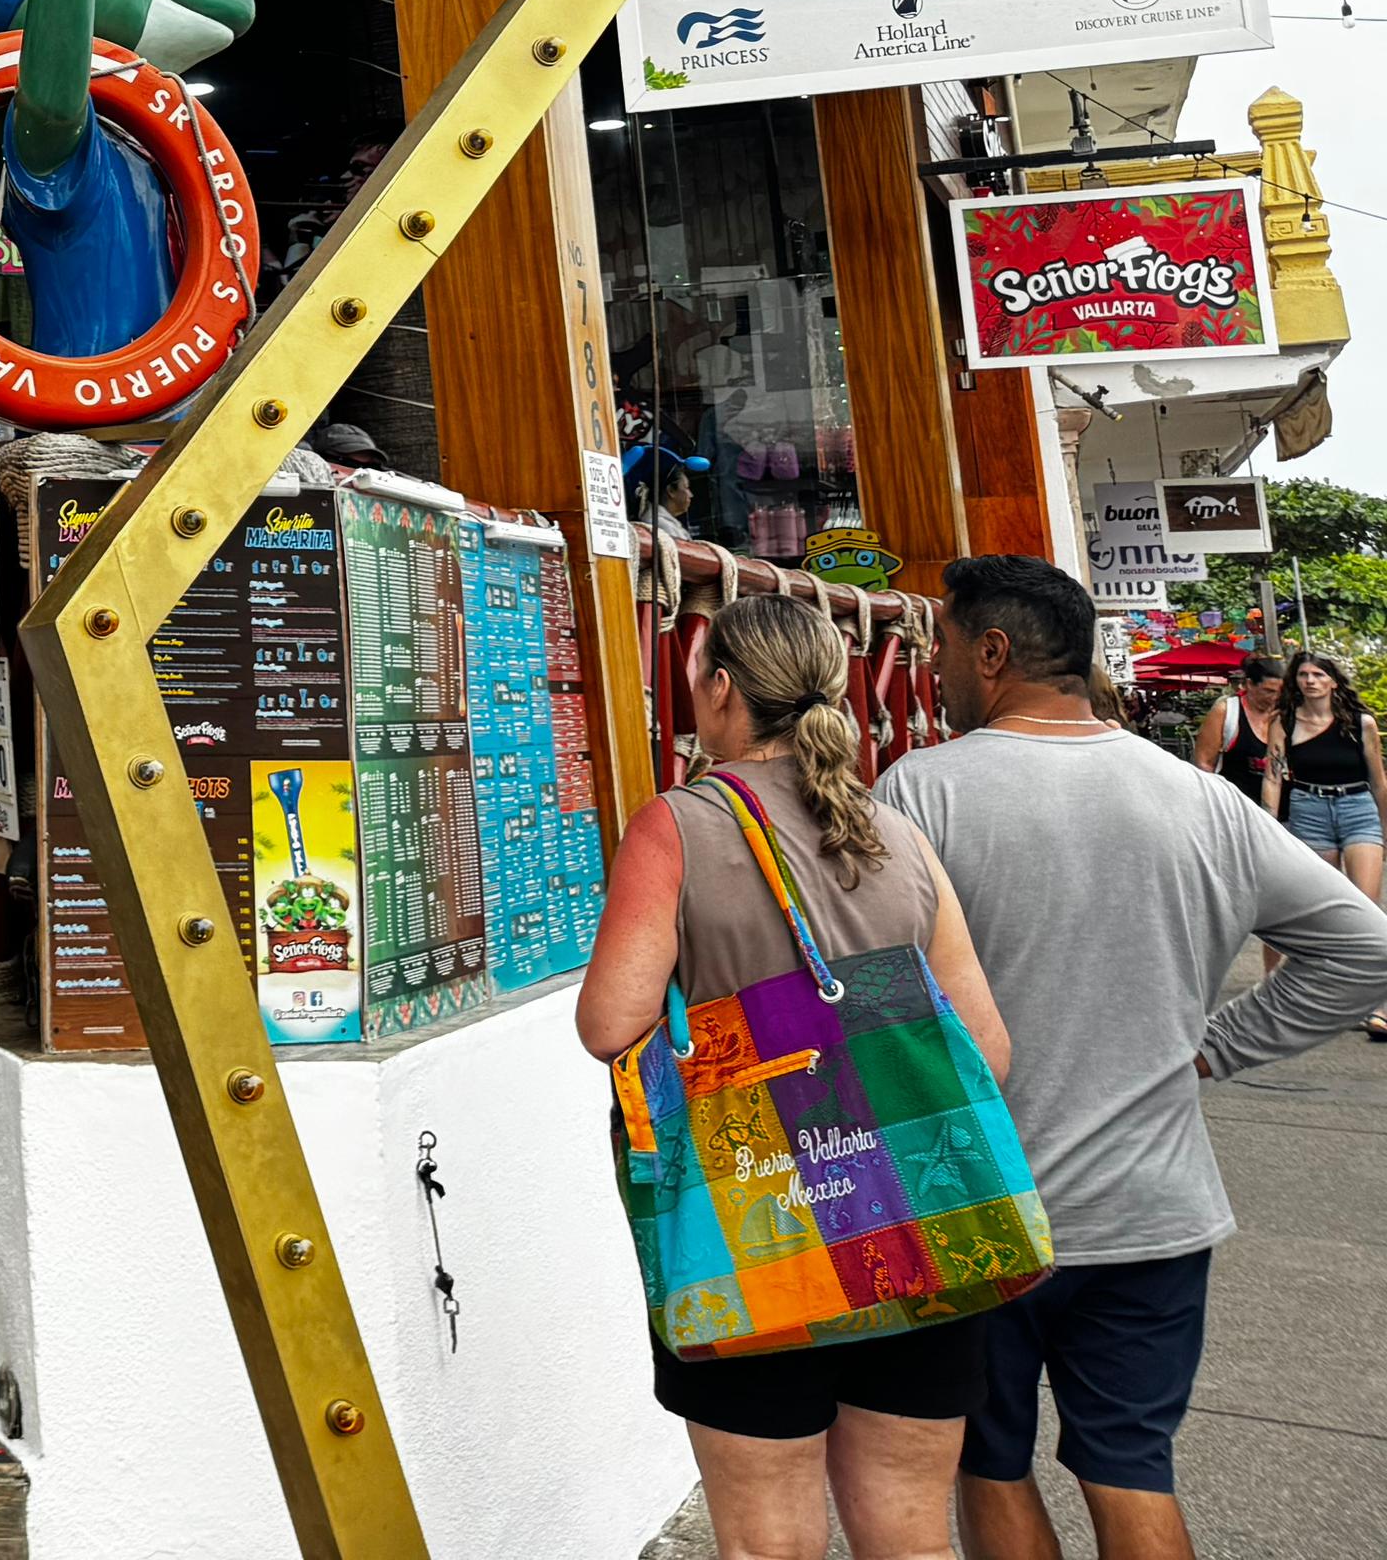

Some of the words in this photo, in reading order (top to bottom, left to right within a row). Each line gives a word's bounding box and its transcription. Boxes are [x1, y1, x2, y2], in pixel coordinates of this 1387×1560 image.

[877, 19, 948, 43] Holland
[1075, 15, 1138, 31] DISCOVERY
[1141, 9, 1184, 24] CRUISE
[681, 48, 770, 71] PRINCESS
[854, 40, 927, 60] America
[147, 88, 193, 131] SR
[567, 239, 586, 267] No.
[992, 261, 1118, 314] Señor
[1119, 245, 1236, 306] Frog's
[1072, 300, 1157, 321] VALLARTA
[73, 324, 218, 407] PUERTO
[265, 506, 315, 536] Señorita
[1105, 504, 1160, 521] buon
[244, 526, 334, 551] MARGARITA
[1136, 523, 1162, 531] GELAT
[186, 776, 232, 799] HOTS
[734, 1145, 795, 1183] Puerto
[797, 1126, 878, 1165] Vallarta
[776, 1172, 857, 1211] Mexico
